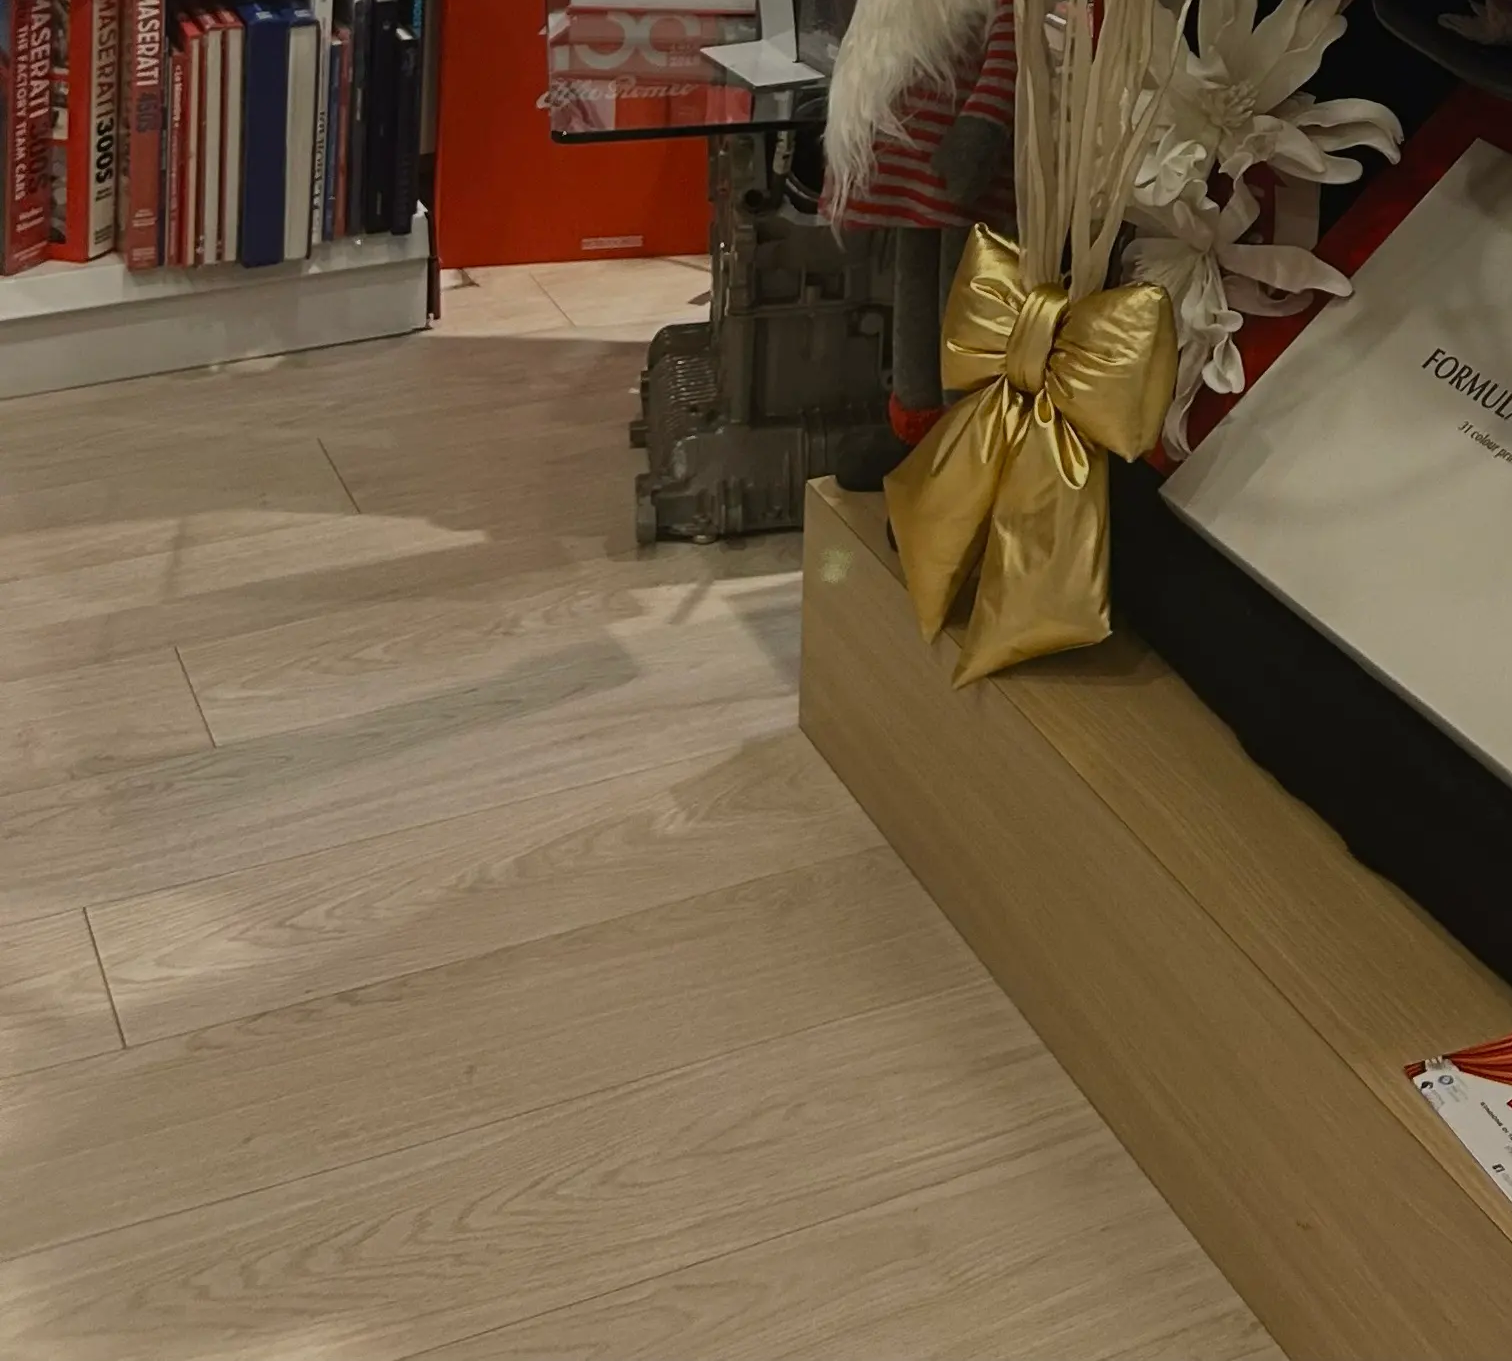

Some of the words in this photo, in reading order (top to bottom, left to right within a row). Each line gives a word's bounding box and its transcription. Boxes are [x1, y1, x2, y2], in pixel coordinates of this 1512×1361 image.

[16, 26, 28, 50] THE
[16, 54, 28, 117] FACTORY
[605, 74, 700, 99] Romeo
[16, 121, 27, 160] TEAM
[96, 119, 115, 184] 300S
[1457, 420, 1474, 433] 31
[1470, 429, 1500, 452] colour
